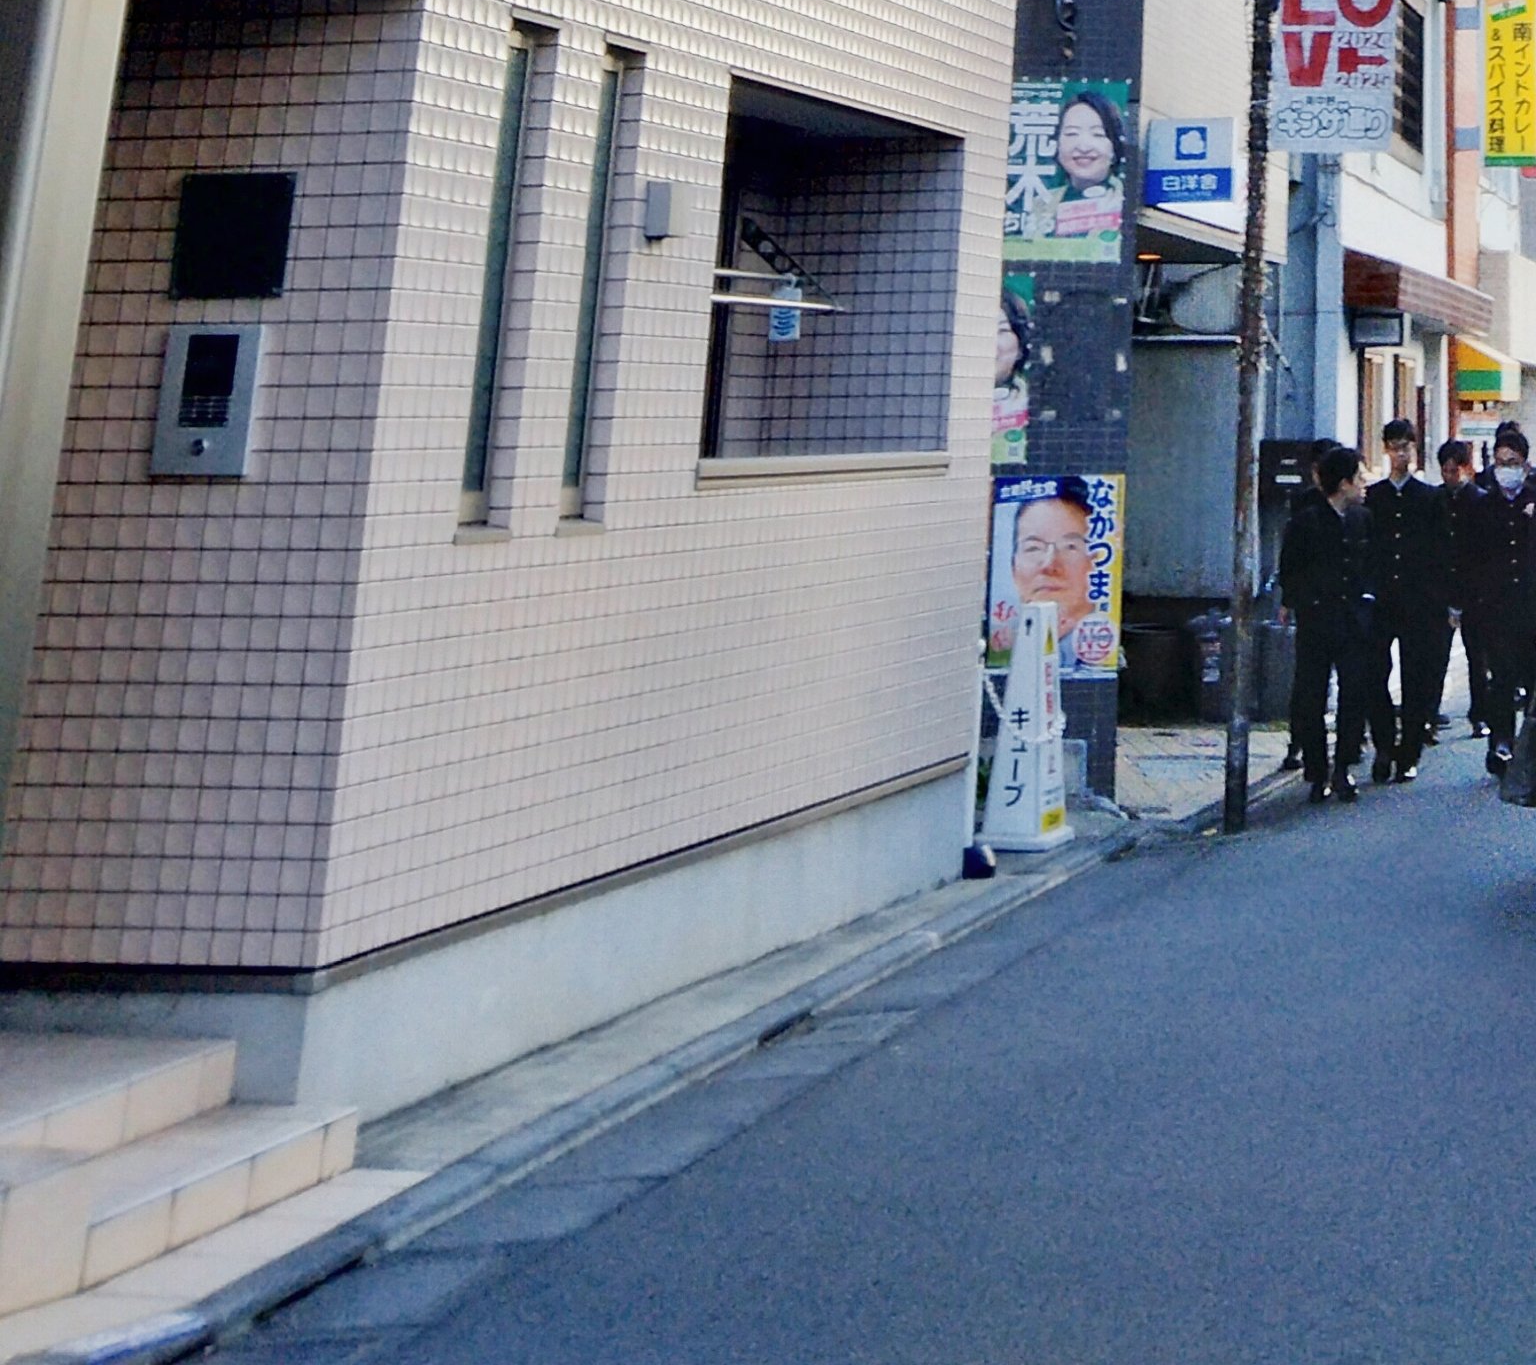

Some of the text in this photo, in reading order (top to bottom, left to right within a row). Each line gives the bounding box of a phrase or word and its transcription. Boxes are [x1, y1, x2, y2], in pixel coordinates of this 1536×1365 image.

[1513, 22, 1532, 151] 南インドカレー
[1006, 100, 1060, 215] 荒木
